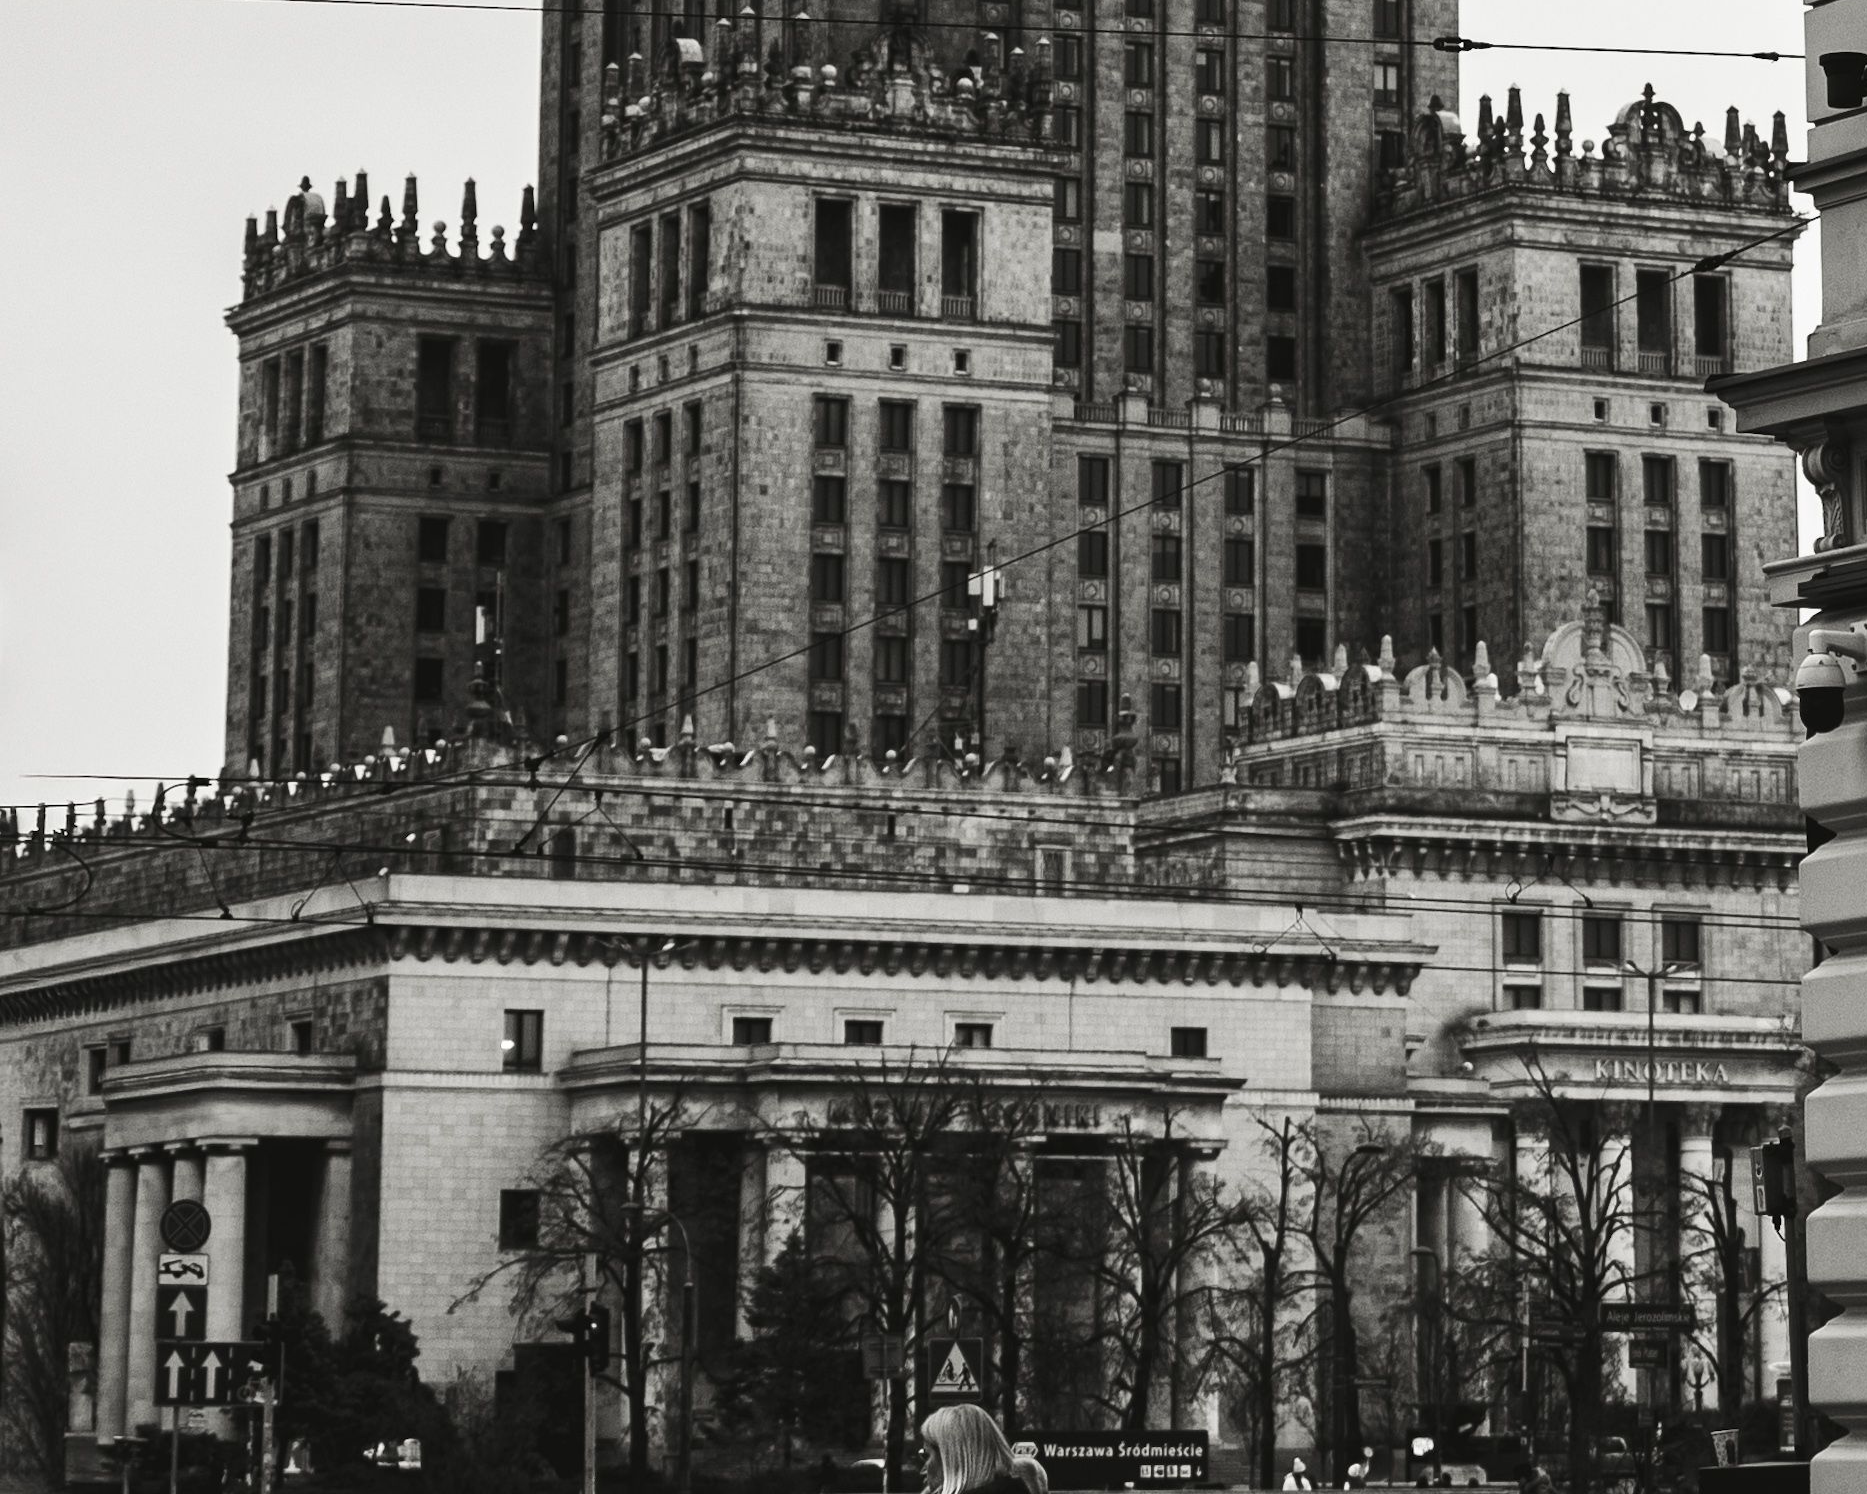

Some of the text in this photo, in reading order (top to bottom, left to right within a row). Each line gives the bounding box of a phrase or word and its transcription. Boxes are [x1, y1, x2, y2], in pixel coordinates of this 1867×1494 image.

[1595, 1059, 1729, 1082] KINOTEKA
[1044, 1443, 1114, 1458] Warszawa
[1118, 1440, 1204, 1458] Śródmieście
